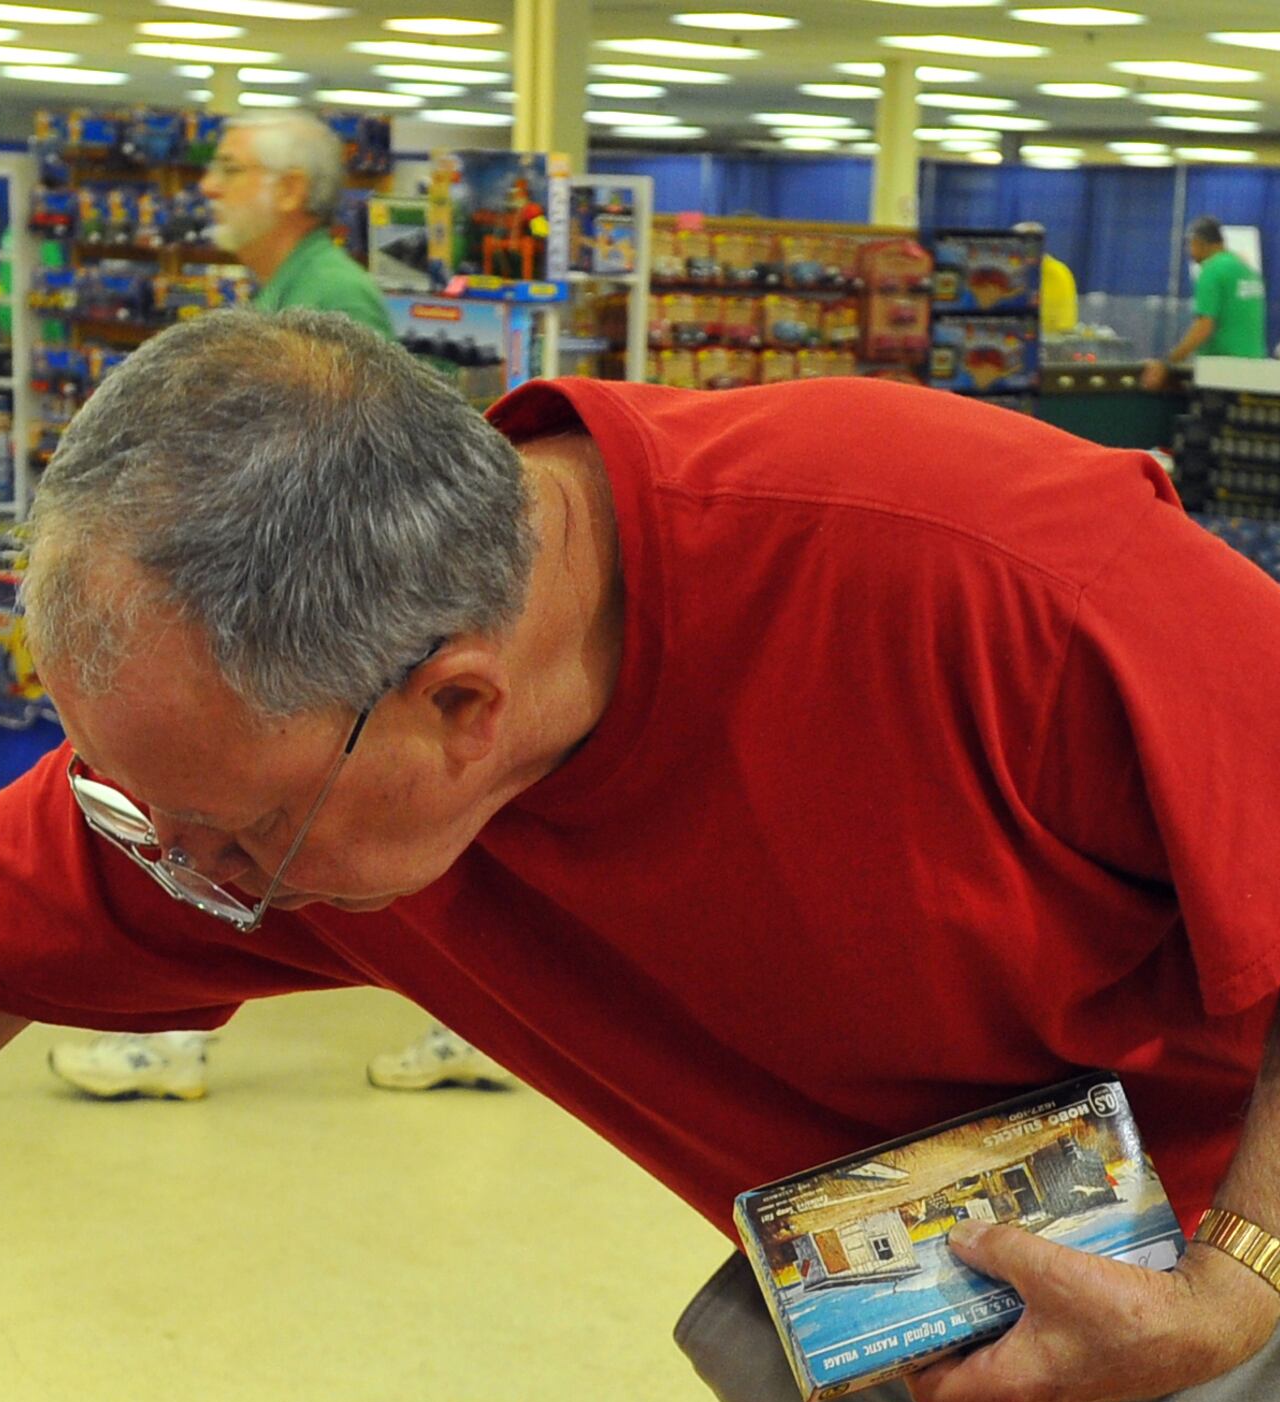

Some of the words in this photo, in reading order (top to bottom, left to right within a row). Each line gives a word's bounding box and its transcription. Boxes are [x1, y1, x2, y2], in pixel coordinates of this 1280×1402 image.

[1048, 1103, 1090, 1125] HOBO
[903, 1320, 946, 1347] Original
[862, 1335, 900, 1356] PLASTIC
[822, 1352, 860, 1371] VILLAGE
